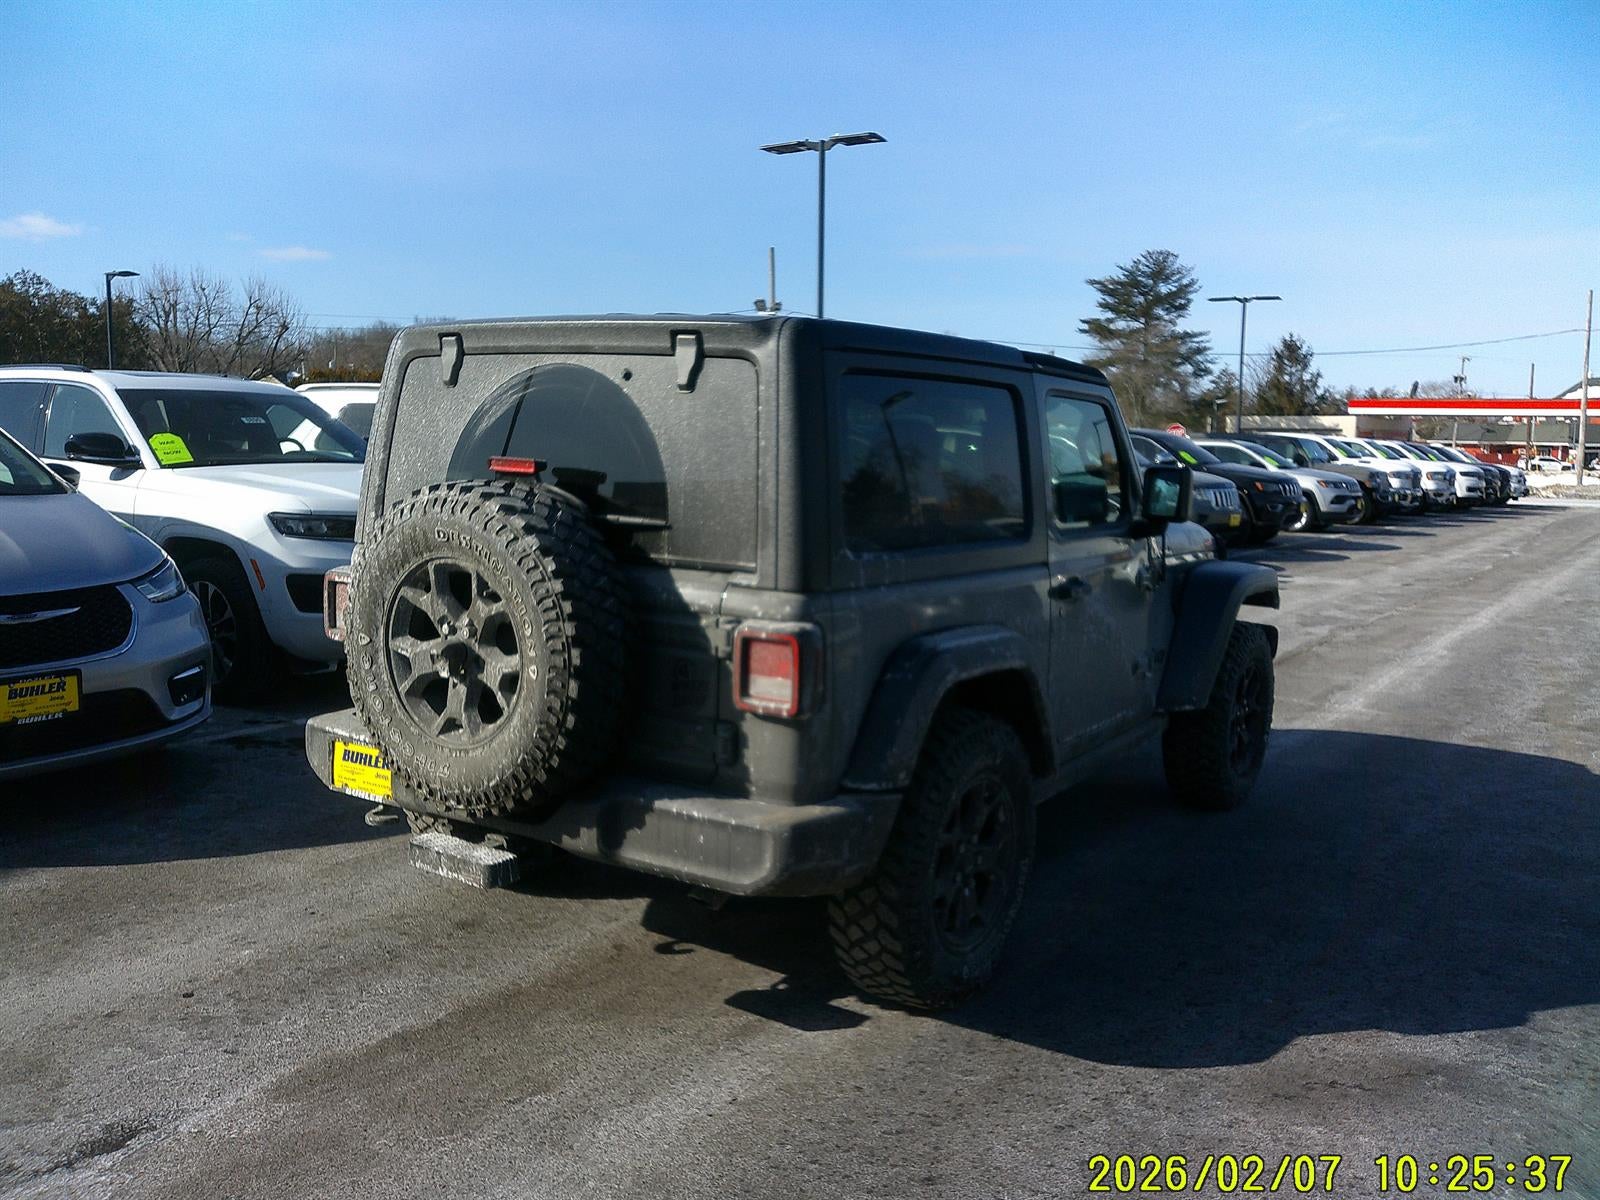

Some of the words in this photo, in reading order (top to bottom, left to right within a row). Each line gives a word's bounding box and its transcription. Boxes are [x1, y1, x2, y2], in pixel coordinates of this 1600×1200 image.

[434, 526, 537, 659] DESTINATION
[8, 681, 66, 700] BUHLER
[342, 748, 390, 770] BUHLER
